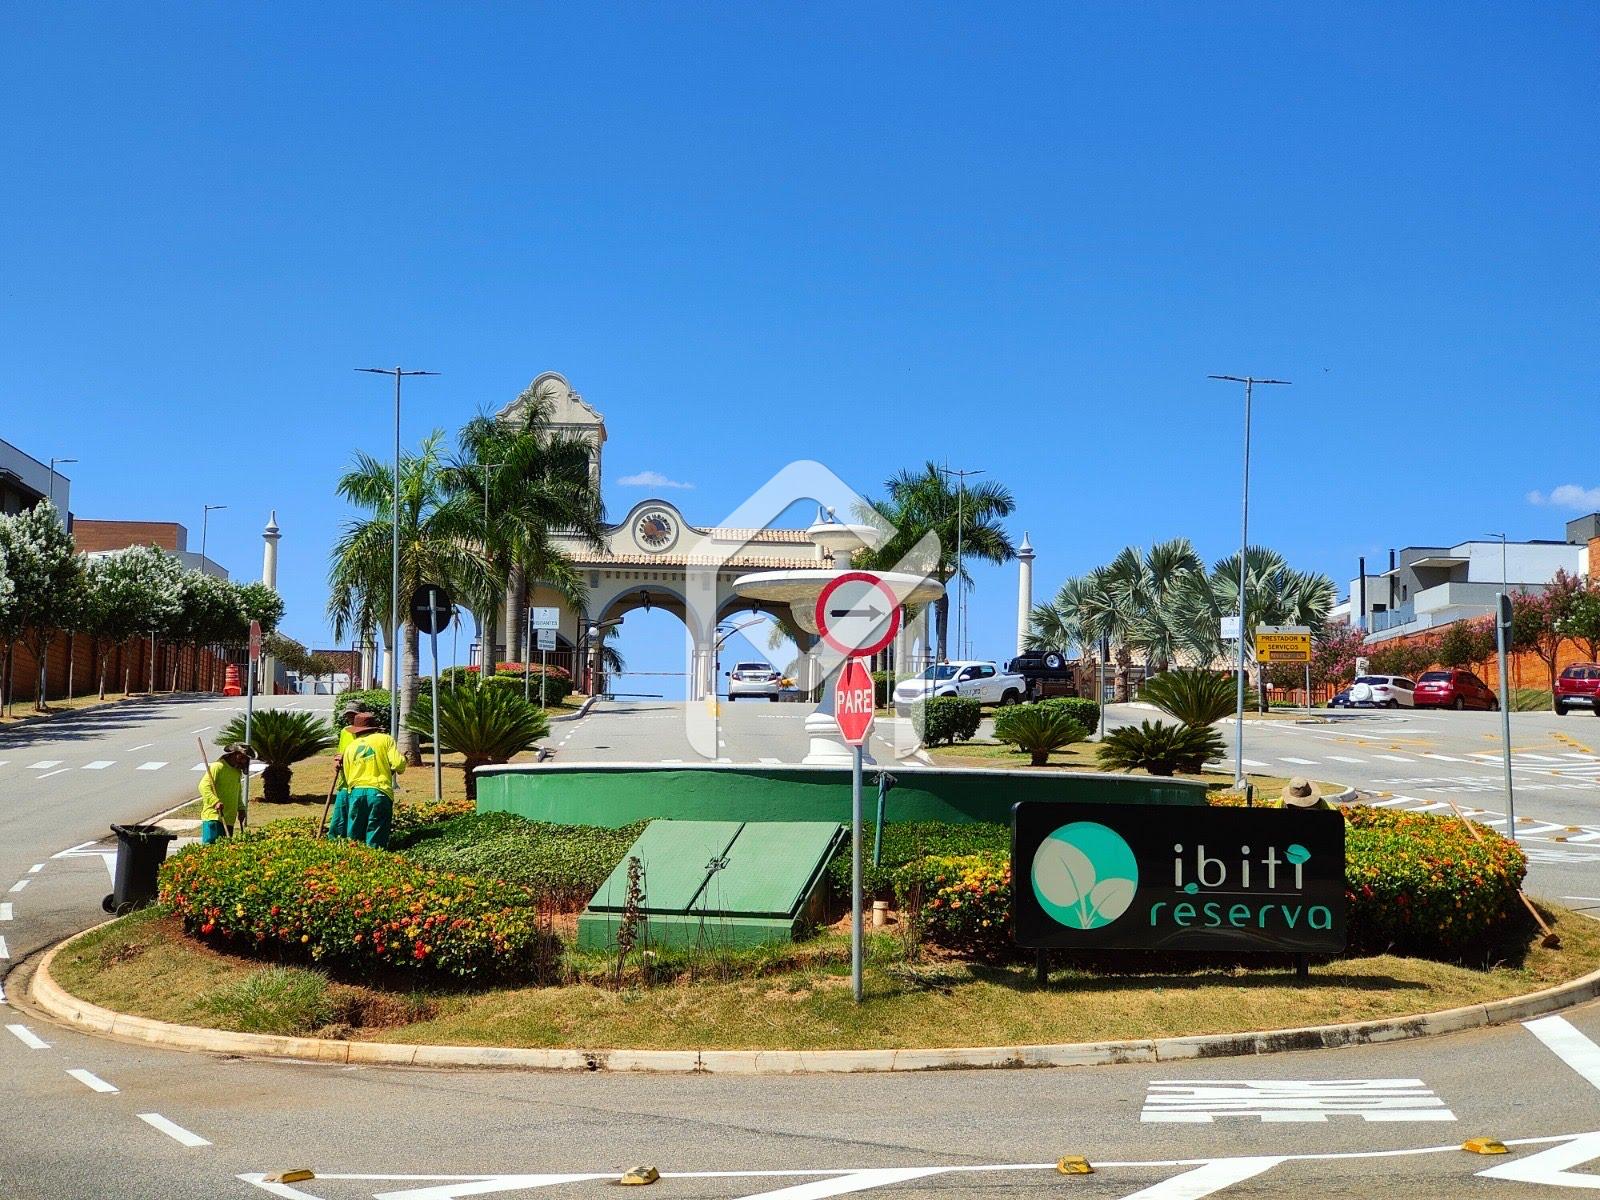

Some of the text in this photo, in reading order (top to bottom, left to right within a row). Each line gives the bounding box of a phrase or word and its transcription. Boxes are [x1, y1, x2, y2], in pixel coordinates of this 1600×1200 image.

[837, 688, 872, 714] PARE
[1174, 843, 1311, 890] ibiti
[1150, 902, 1332, 930] reserva
